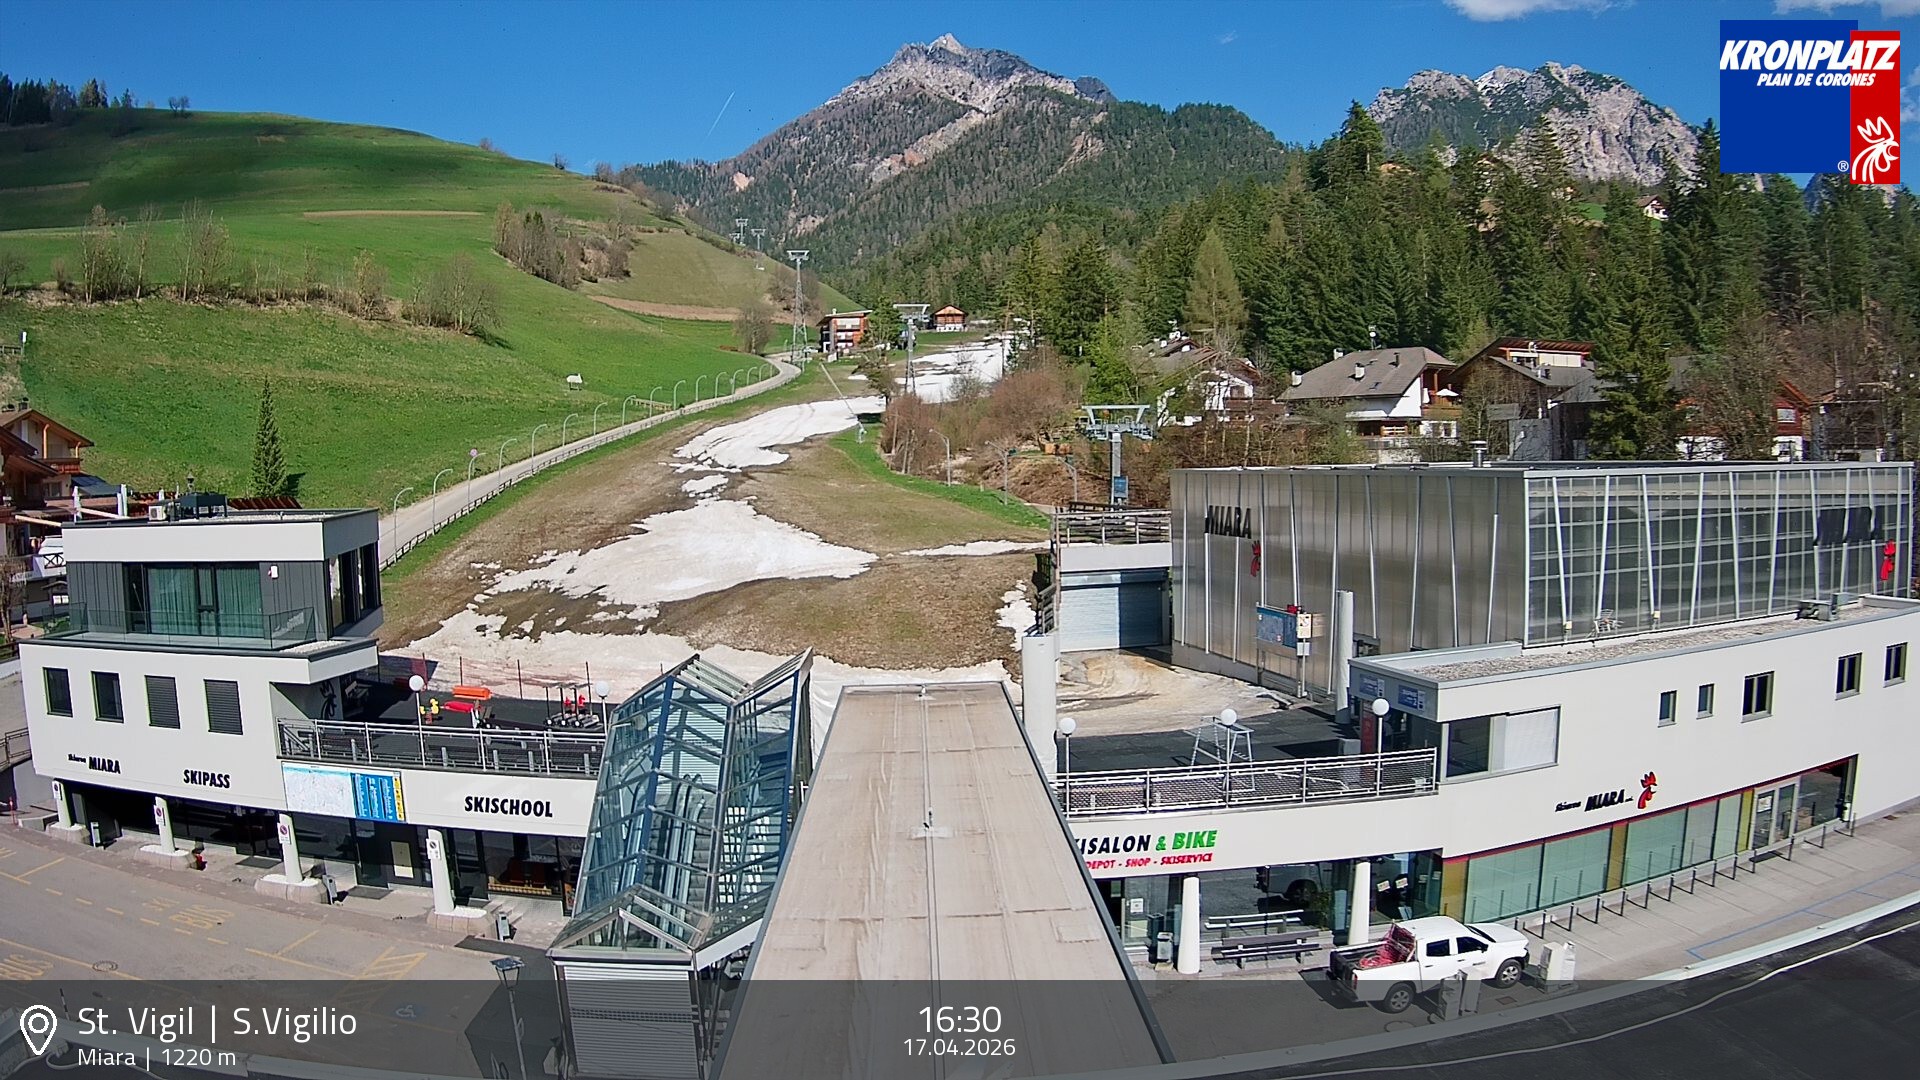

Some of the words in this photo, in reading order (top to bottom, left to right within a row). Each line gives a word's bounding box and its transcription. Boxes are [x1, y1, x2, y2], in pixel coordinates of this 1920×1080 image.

[1204, 505, 1251, 539] MIARA
[88, 756, 121, 774] MIARA
[183, 769, 231, 788] SKIPASS
[464, 796, 553, 818] SKISCHOOL
[1584, 789, 1625, 812] MIARA
[1075, 835, 1152, 855] ISALON
[1155, 836, 1167, 851] &
[1172, 830, 1218, 850] BIKE
[1086, 860, 1116, 869] DEPOT
[1125, 857, 1151, 868] SHOP
[1160, 853, 1213, 866] SKISERVICE
[168, 904, 235, 929] BUS
